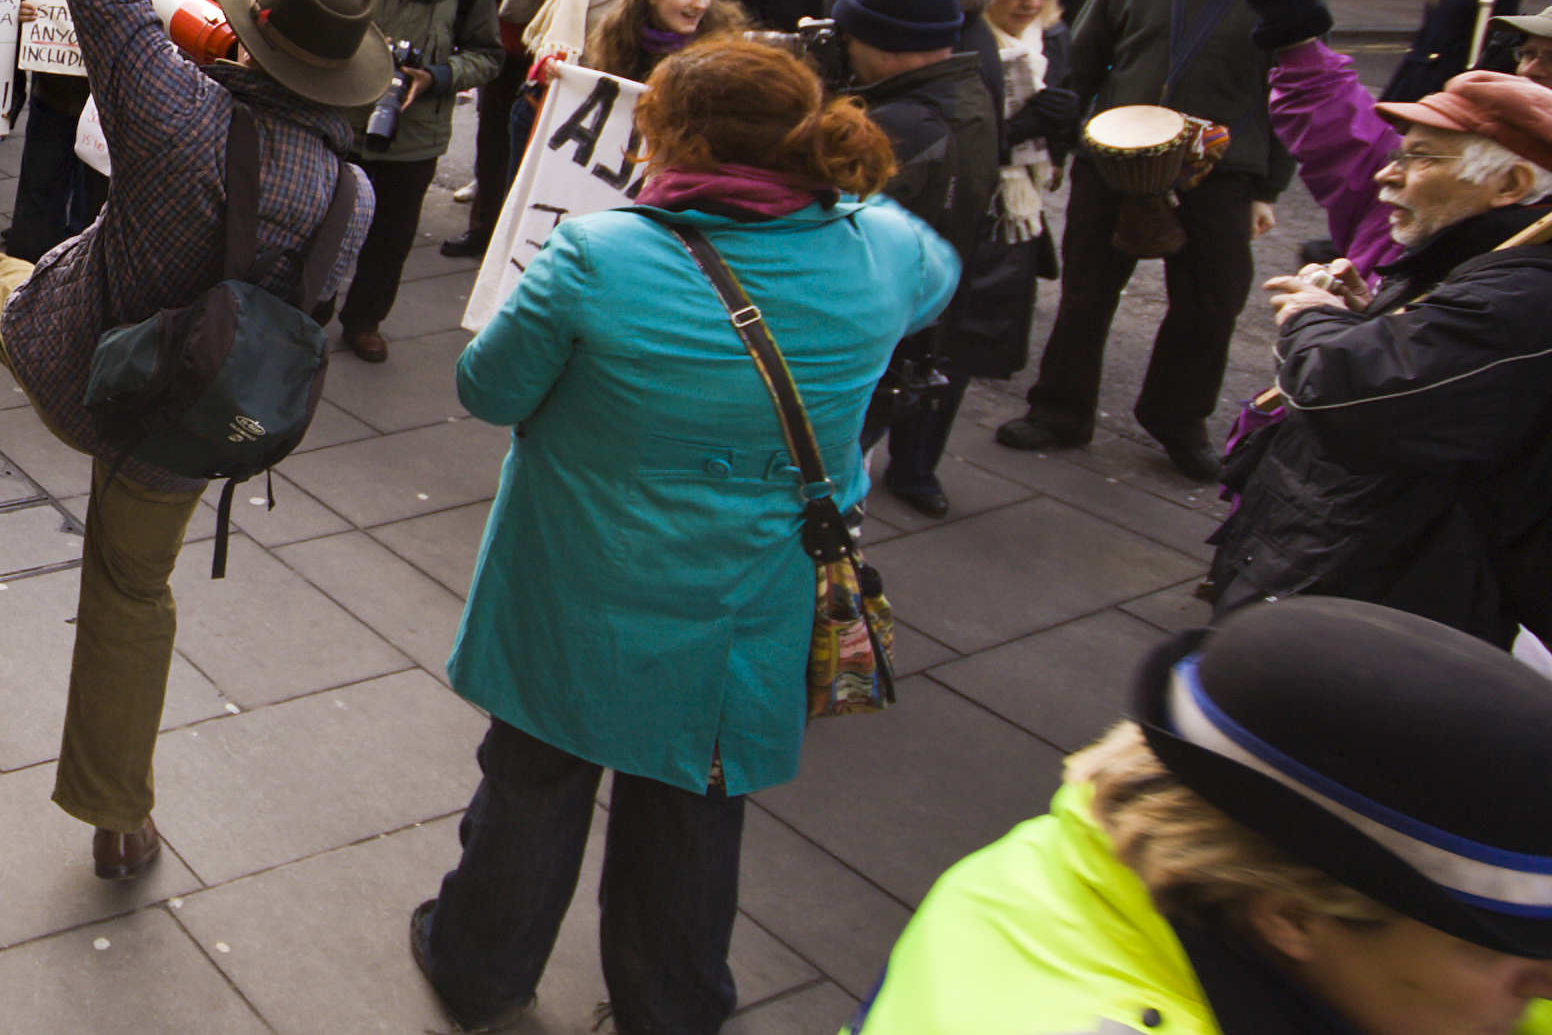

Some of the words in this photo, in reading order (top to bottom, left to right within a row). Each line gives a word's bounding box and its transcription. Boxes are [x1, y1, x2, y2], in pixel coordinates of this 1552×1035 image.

[0, 12, 14, 26] A
[37, 4, 71, 21] STA
[30, 24, 78, 45] ANYO
